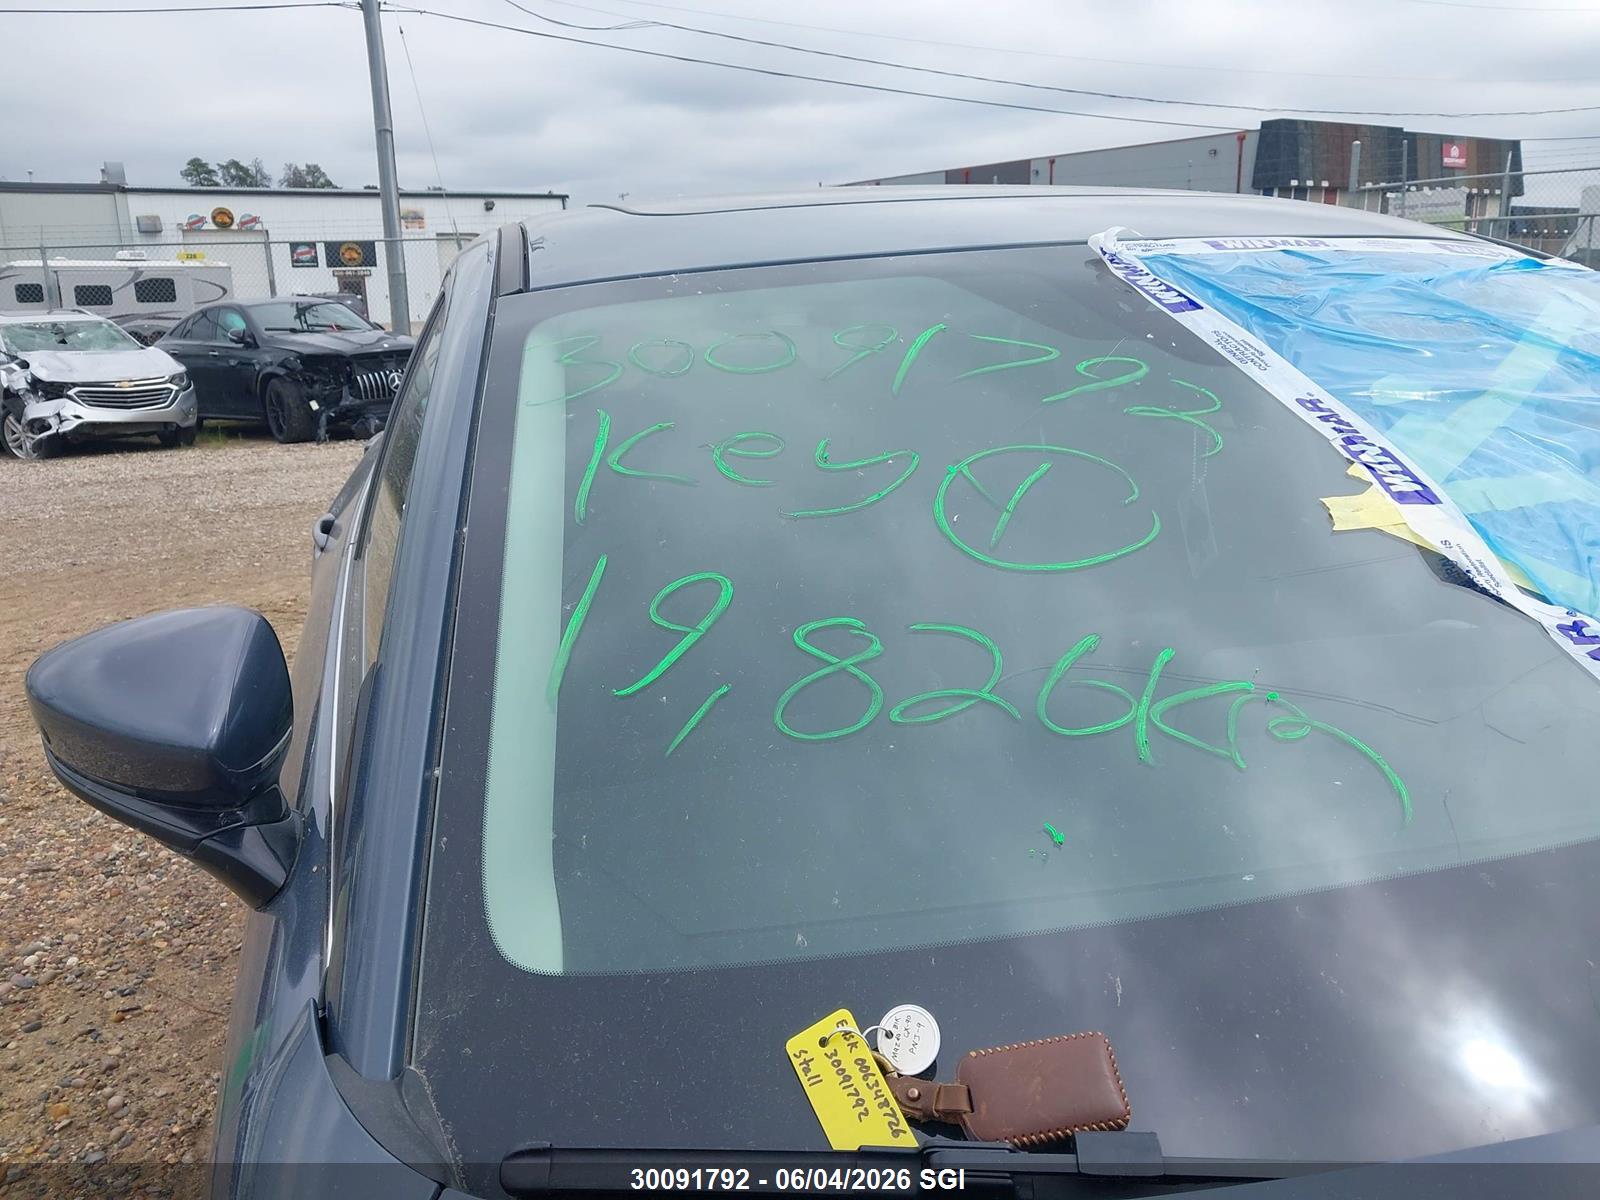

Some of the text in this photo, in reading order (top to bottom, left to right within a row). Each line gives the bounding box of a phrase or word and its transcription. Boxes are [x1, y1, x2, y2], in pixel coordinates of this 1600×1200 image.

[574, 408, 920, 525] Key
[793, 1049, 824, 1087] Stall
[824, 1048, 870, 1123] 30091792
[853, 1057, 907, 1139] 006348726
